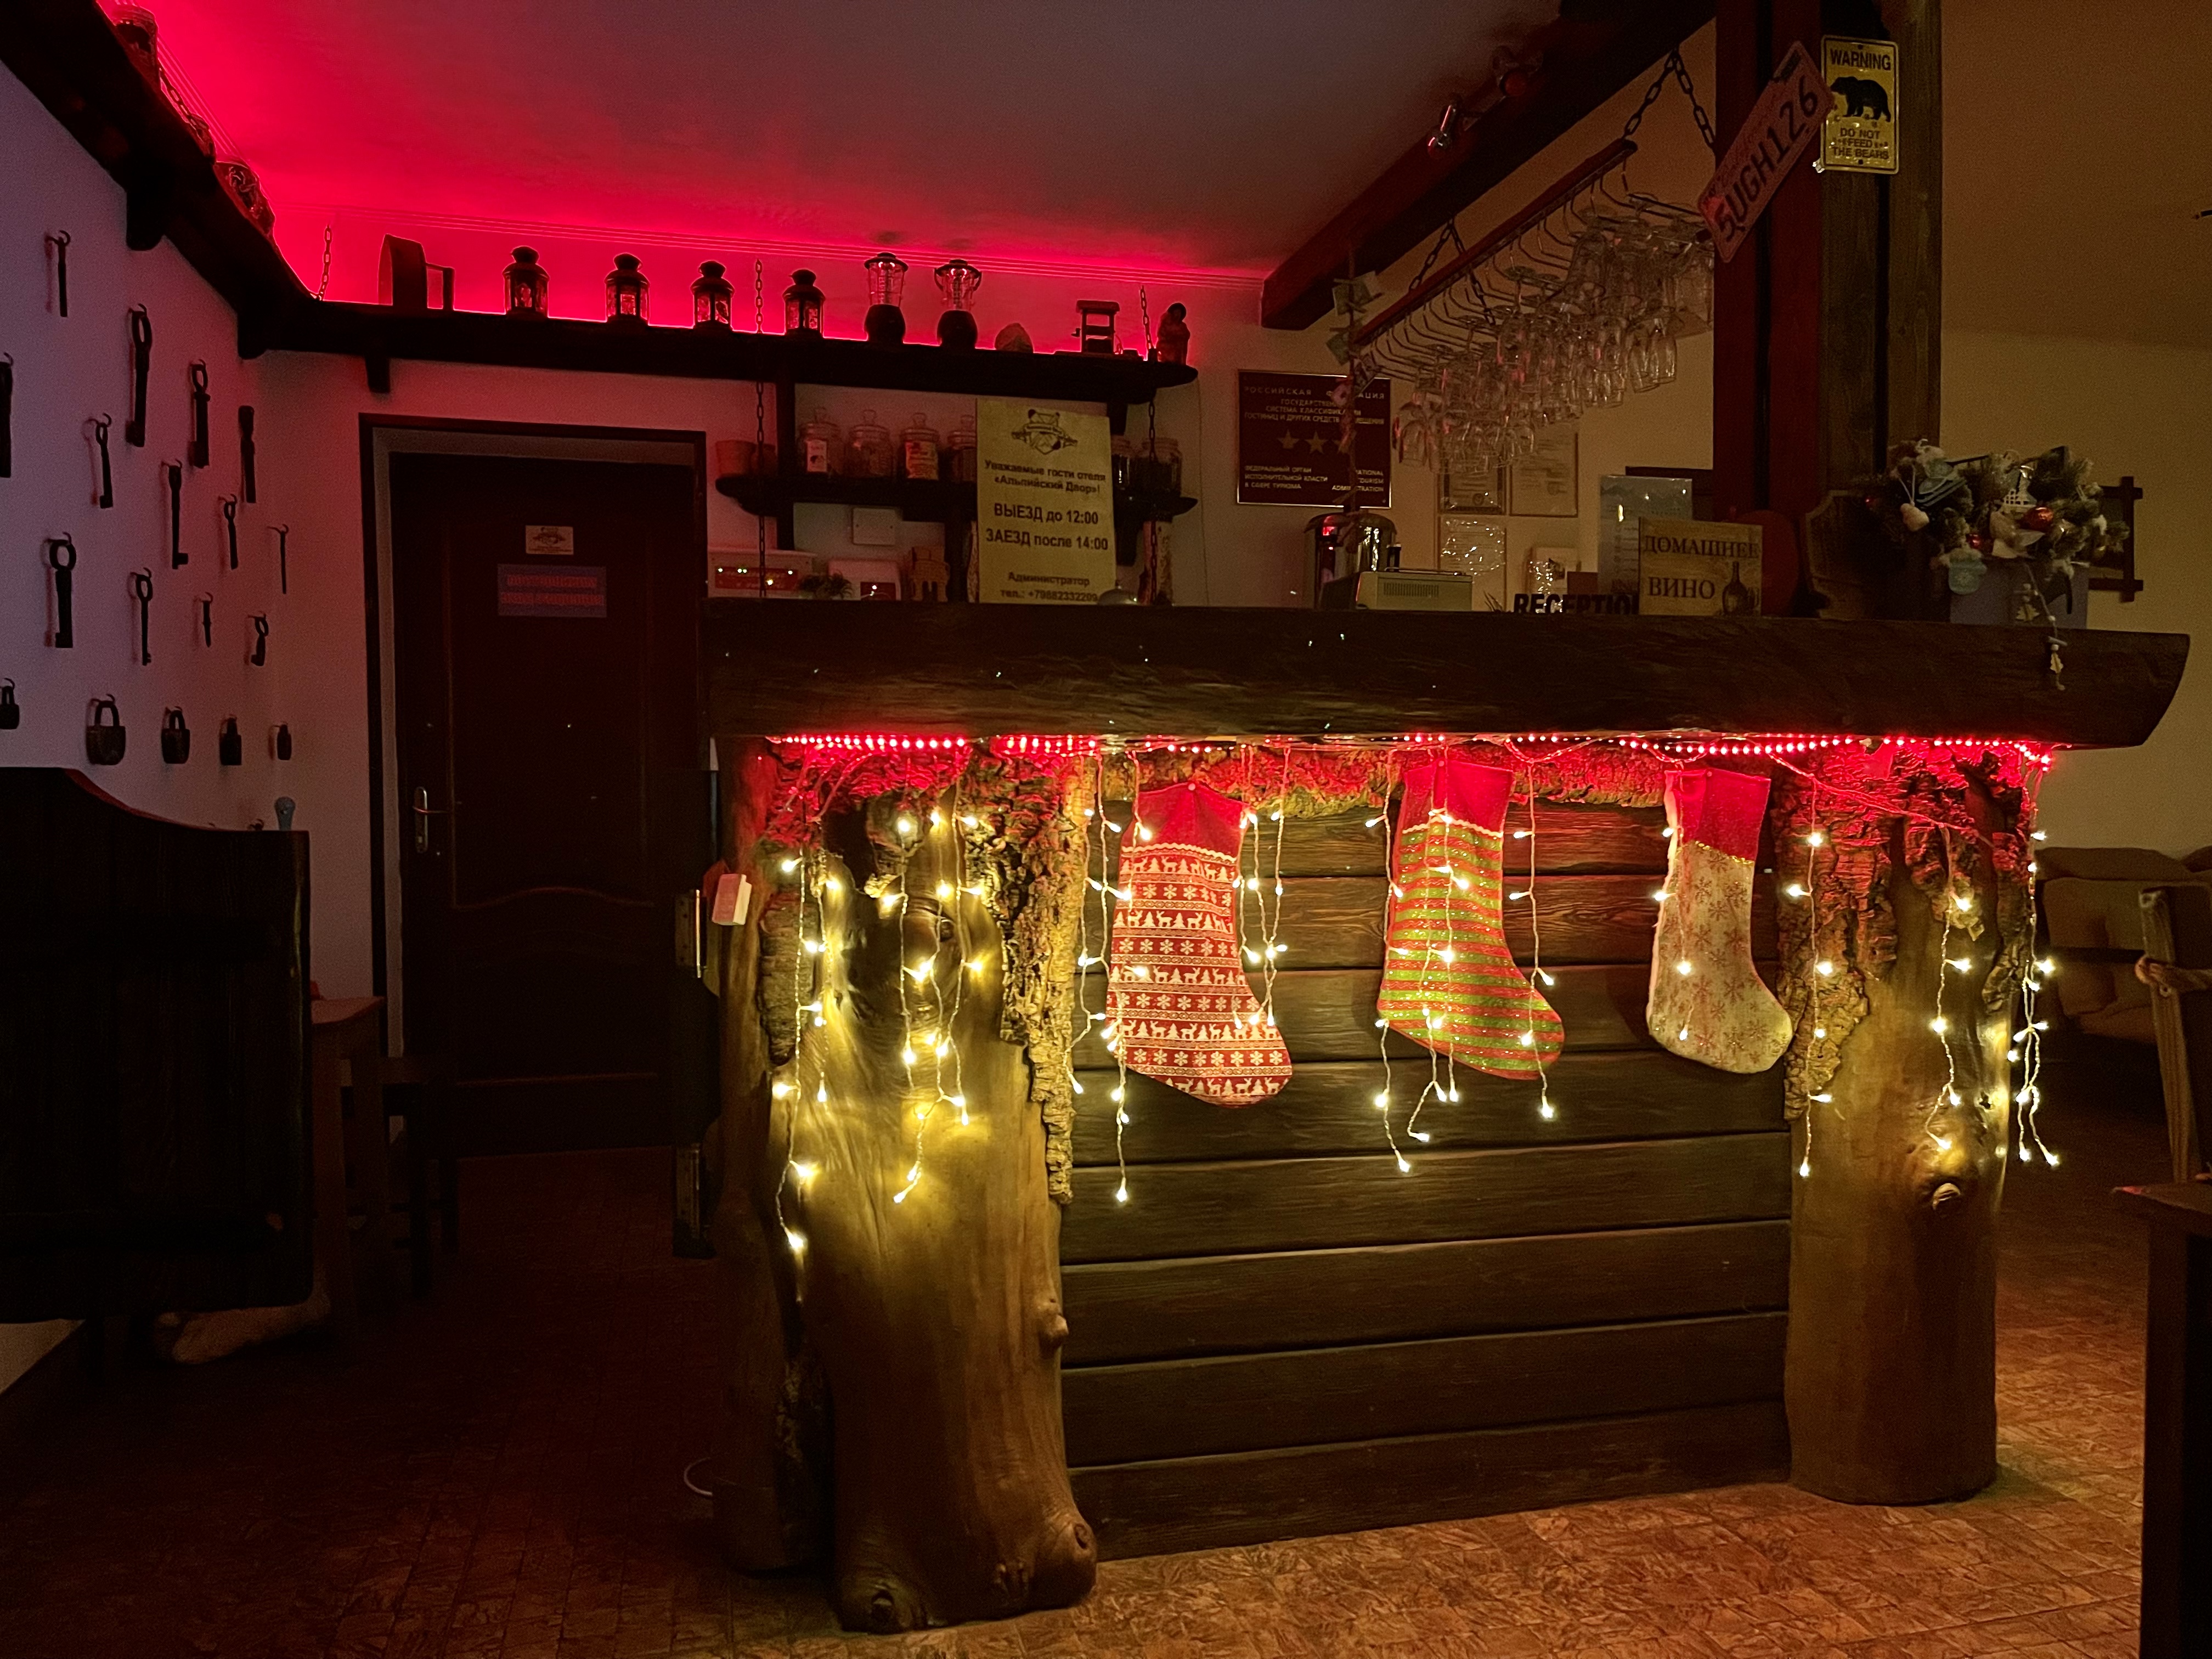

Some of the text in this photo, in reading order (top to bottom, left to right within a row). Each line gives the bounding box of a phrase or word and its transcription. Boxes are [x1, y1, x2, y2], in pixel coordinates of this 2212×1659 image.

[1830, 49, 1891, 70] WARNING
[1840, 128, 1880, 139] DO NOT
[1848, 138, 1872, 148] FEED
[1832, 146, 1889, 160] THE BEARS
[1244, 386, 1312, 395] РОССИЙСКАЯ
[984, 460, 1105, 481] Уважаемые гости отеля
[994, 503, 1098, 524] ВЫЕЗД до 12:00
[986, 528, 1108, 550] ЗАЕЗД после 14:00
[1643, 535, 1759, 559] ДОМАШНЕЕ
[1008, 572, 1090, 588] Администратор
[1647, 577, 1716, 599] ВИНО
